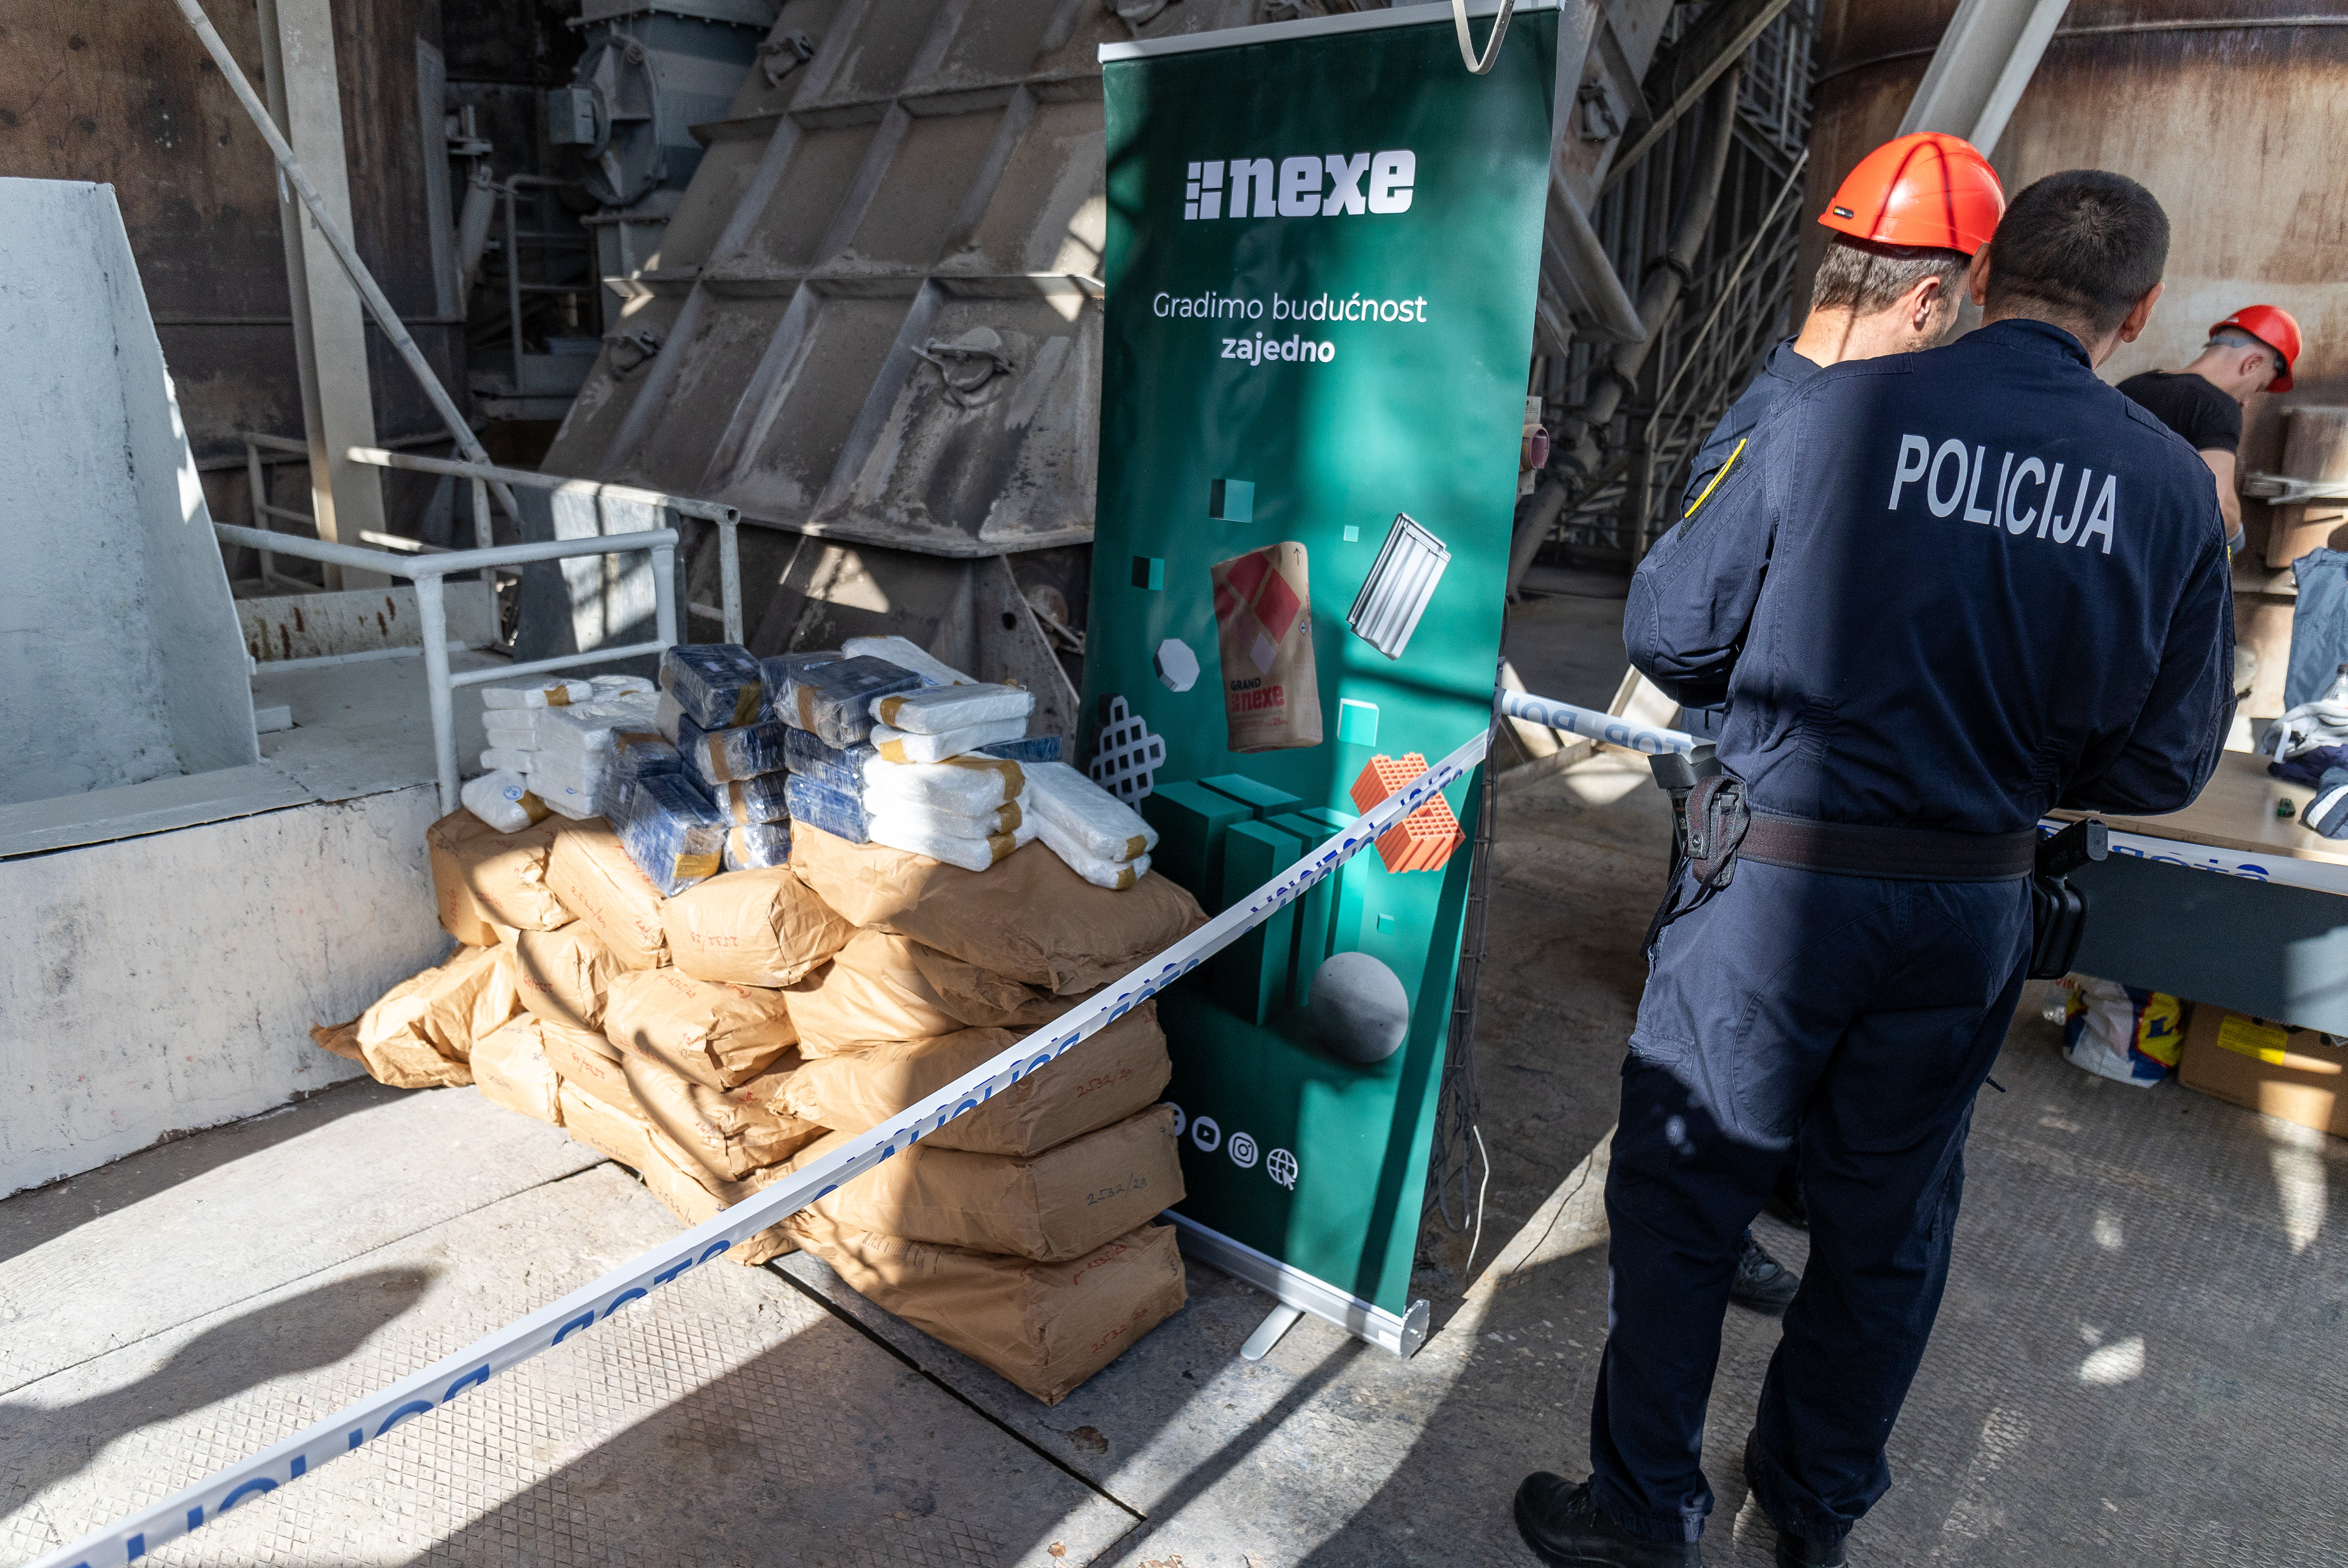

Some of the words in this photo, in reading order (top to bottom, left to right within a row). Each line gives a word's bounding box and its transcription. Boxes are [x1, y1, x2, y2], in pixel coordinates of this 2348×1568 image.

[1229, 150, 1416, 218] nexe
[1153, 292, 1263, 319] Gradimo
[1273, 292, 1428, 323] budućnost
[1221, 332, 1336, 366] zajedno
[1888, 434, 2117, 554] POLICIJA
[1230, 678, 1262, 692] GRAND
[1240, 686, 1285, 712] nexe
[691, 931, 739, 952] 2532/23
[1088, 1172, 1148, 1206] 2532/23
